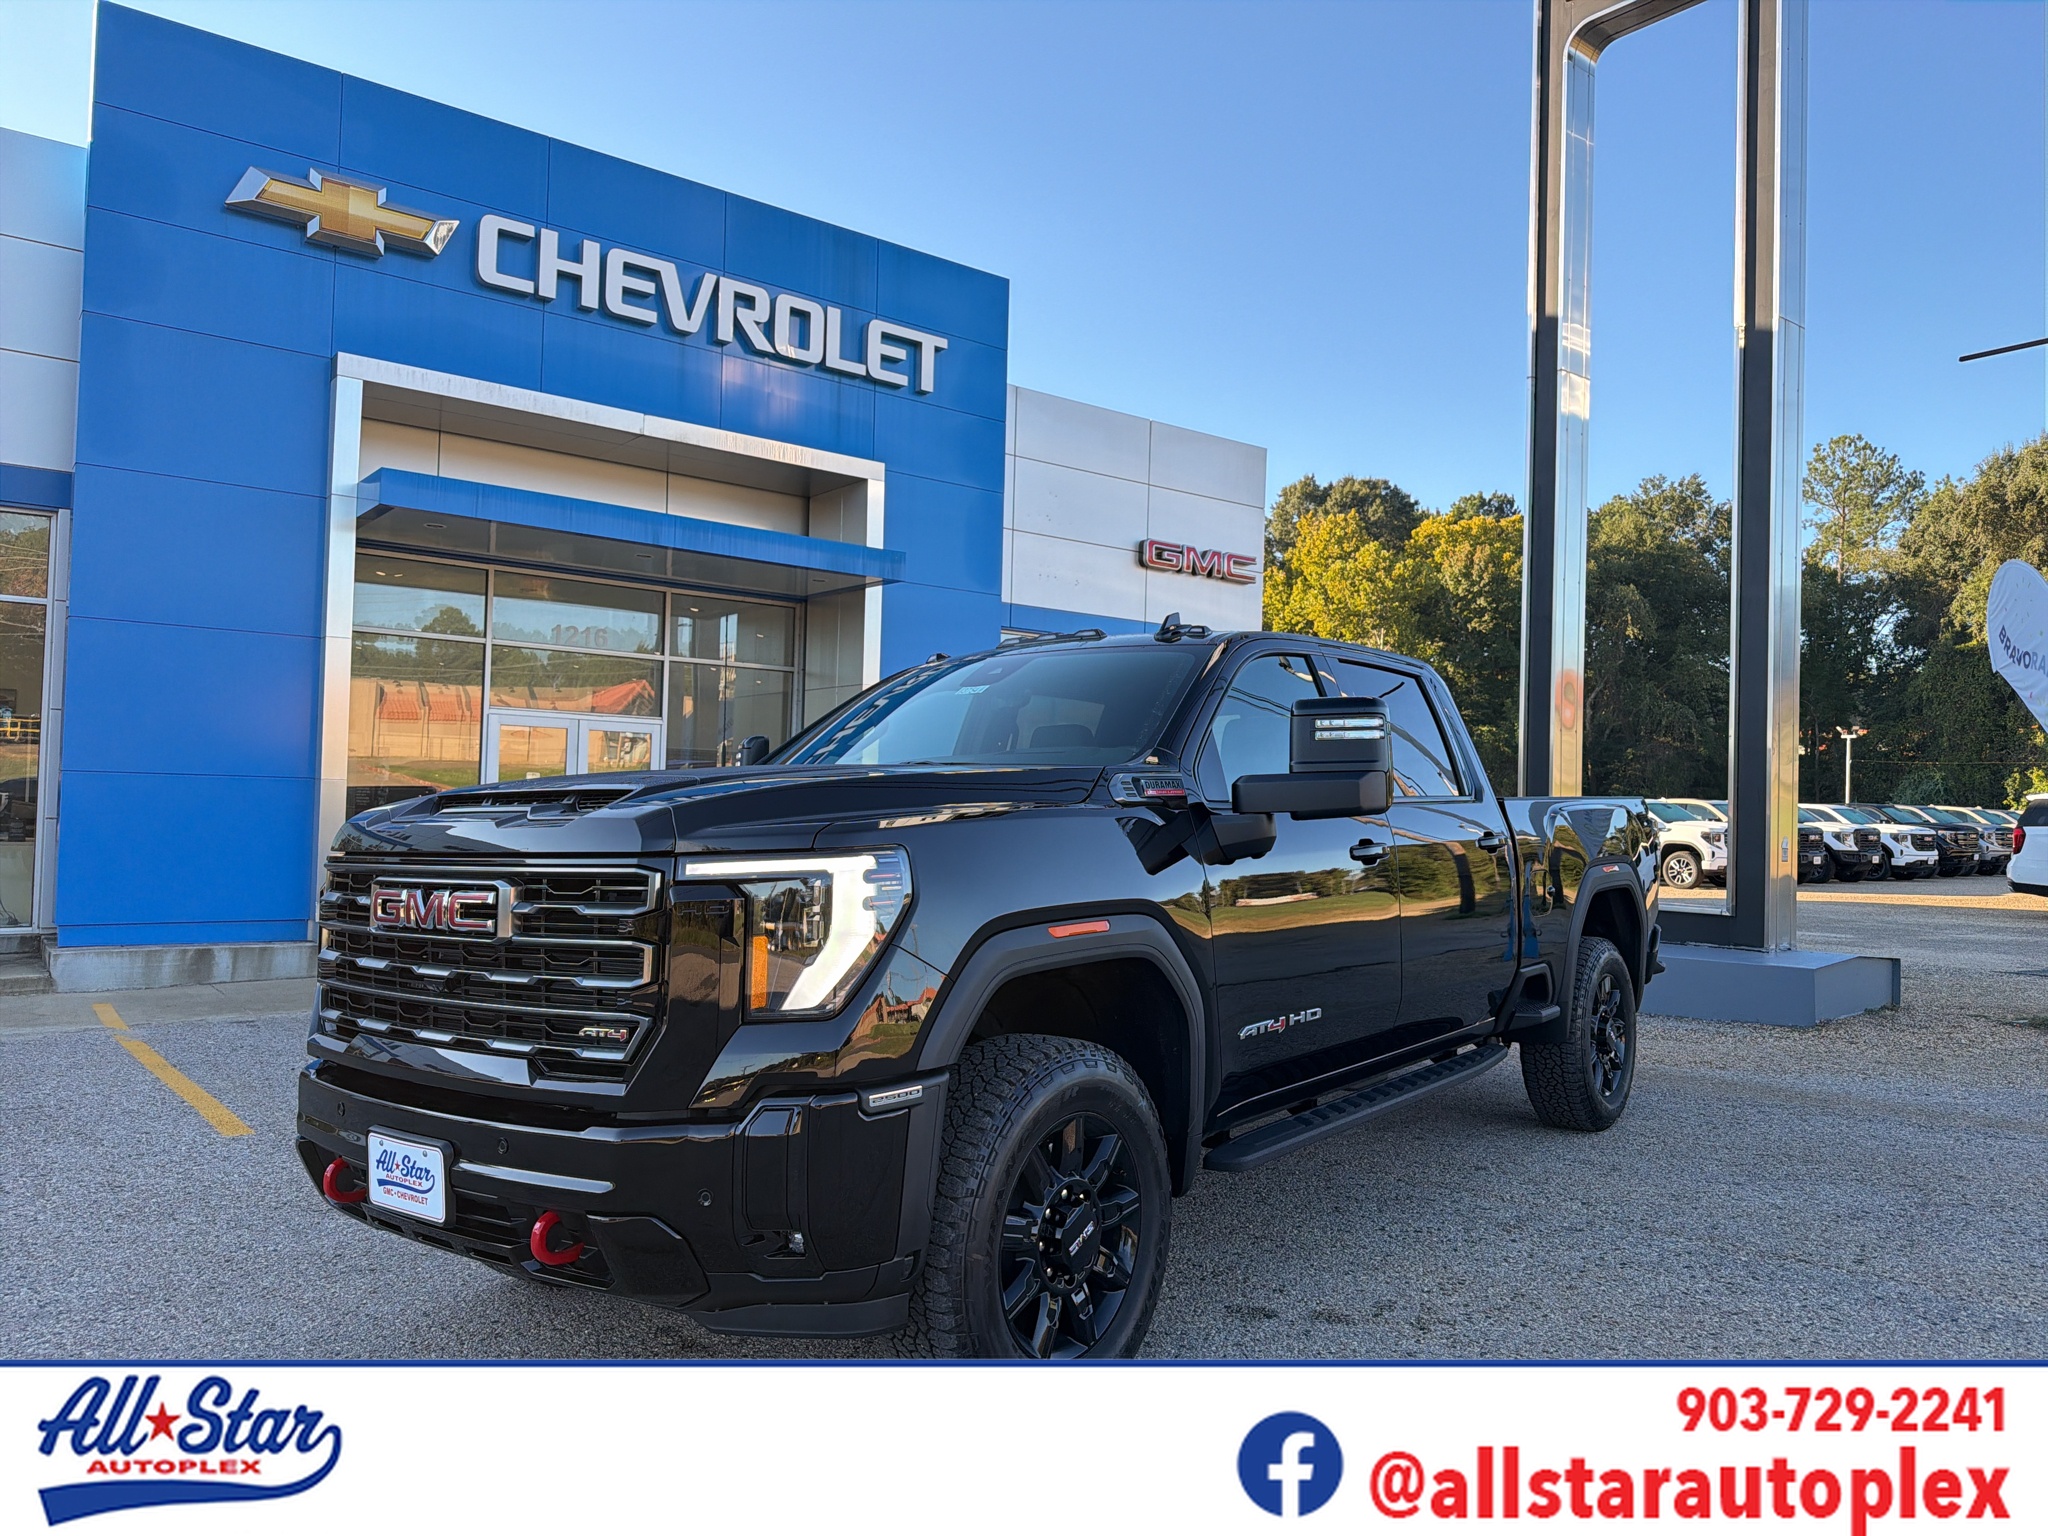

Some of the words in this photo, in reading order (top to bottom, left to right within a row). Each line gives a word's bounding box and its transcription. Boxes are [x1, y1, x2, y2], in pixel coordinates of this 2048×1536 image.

[476, 213, 949, 395] CHEVROLET
[1141, 538, 1258, 584] GMC
[551, 624, 609, 648] 1216
[1144, 780, 1182, 790] DURAMAX
[372, 888, 496, 933] GMC
[579, 1026, 628, 1042] AT4
[1238, 1016, 1286, 1041] AT4
[1289, 1007, 1322, 1027] HD
[870, 1087, 921, 1106] 2500
[376, 1149, 397, 1174] All
[400, 1154, 433, 1182] Star
[385, 1173, 424, 1188] AUTOPLEX
